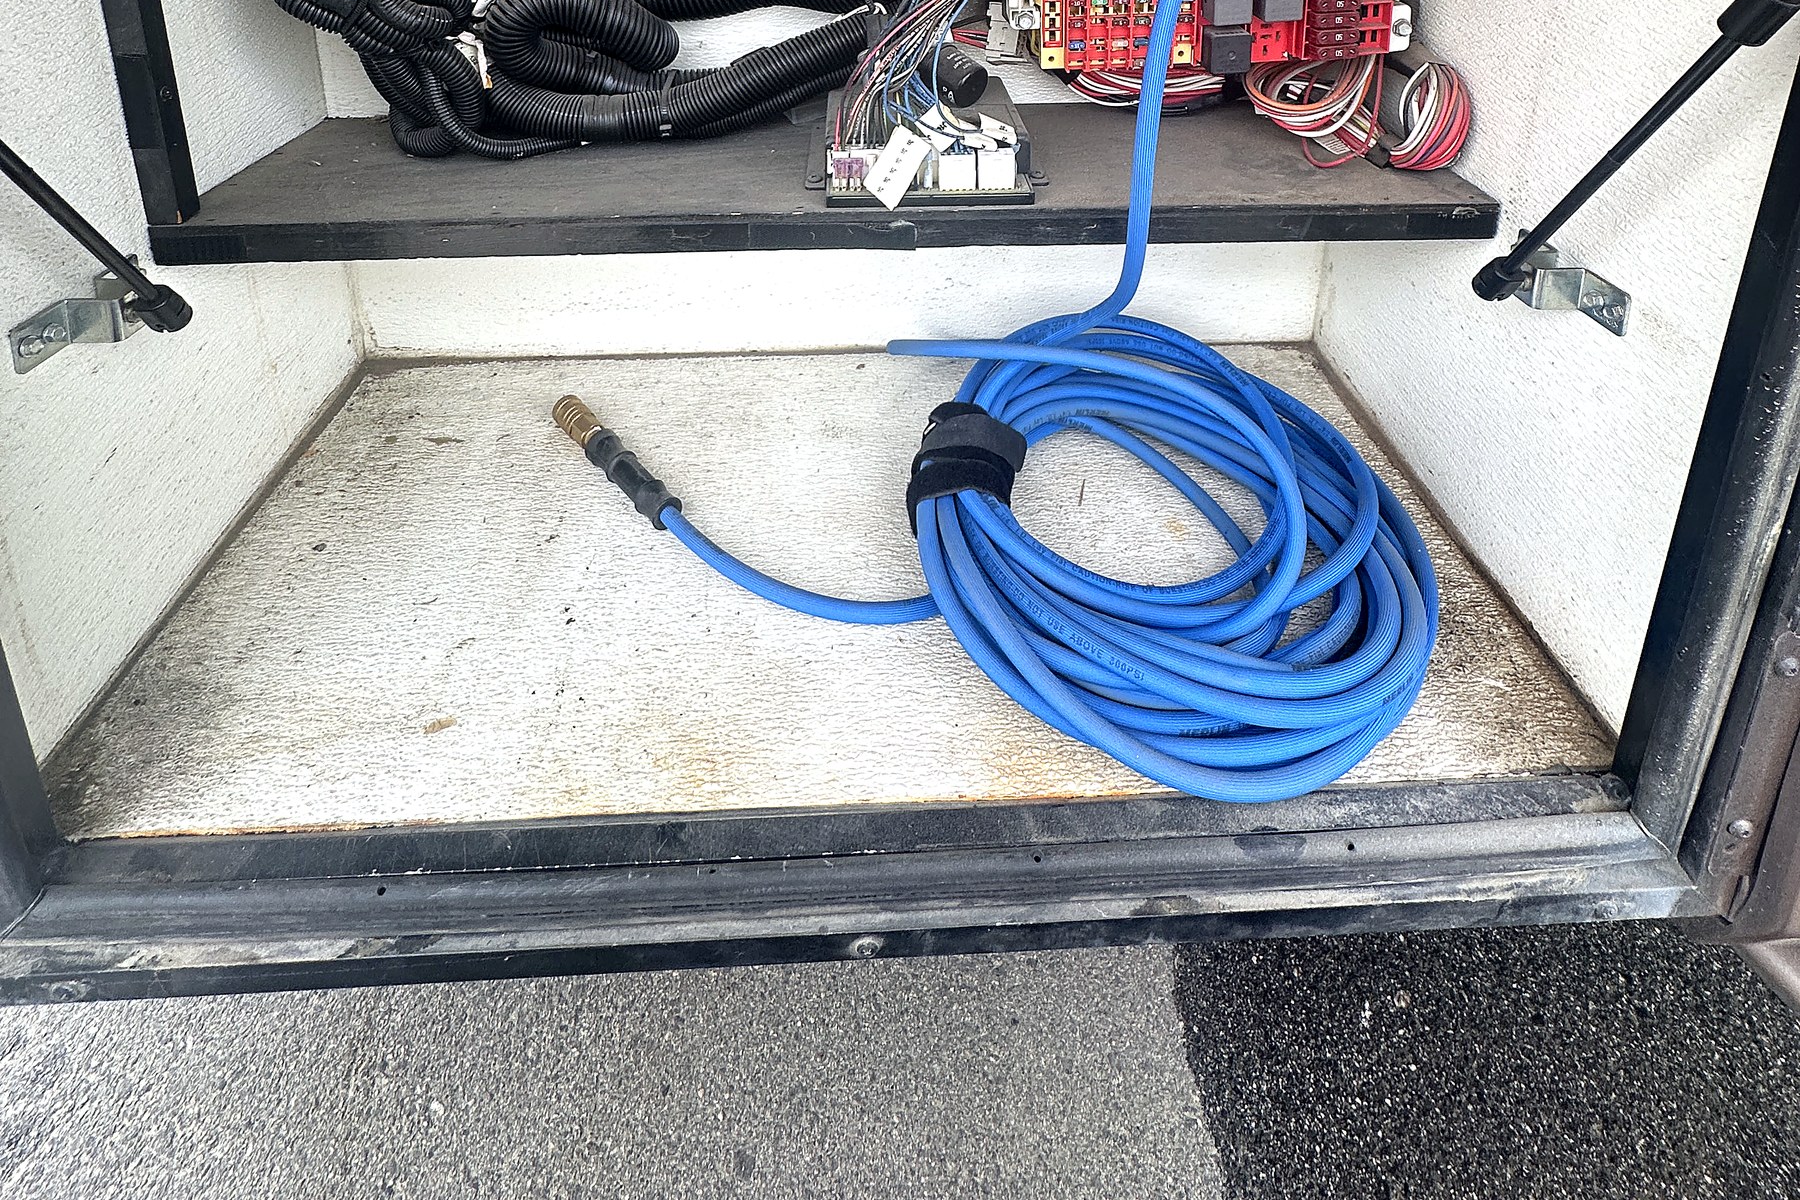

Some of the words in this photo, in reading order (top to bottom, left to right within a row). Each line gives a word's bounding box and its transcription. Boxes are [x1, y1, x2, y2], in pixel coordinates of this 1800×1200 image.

[1220, 360, 1249, 386] MERLIN
[1027, 599, 1043, 618] NOT
[1047, 616, 1065, 635] USE
[1069, 633, 1104, 659] ABOVE
[1108, 656, 1145, 681] 300PSI
